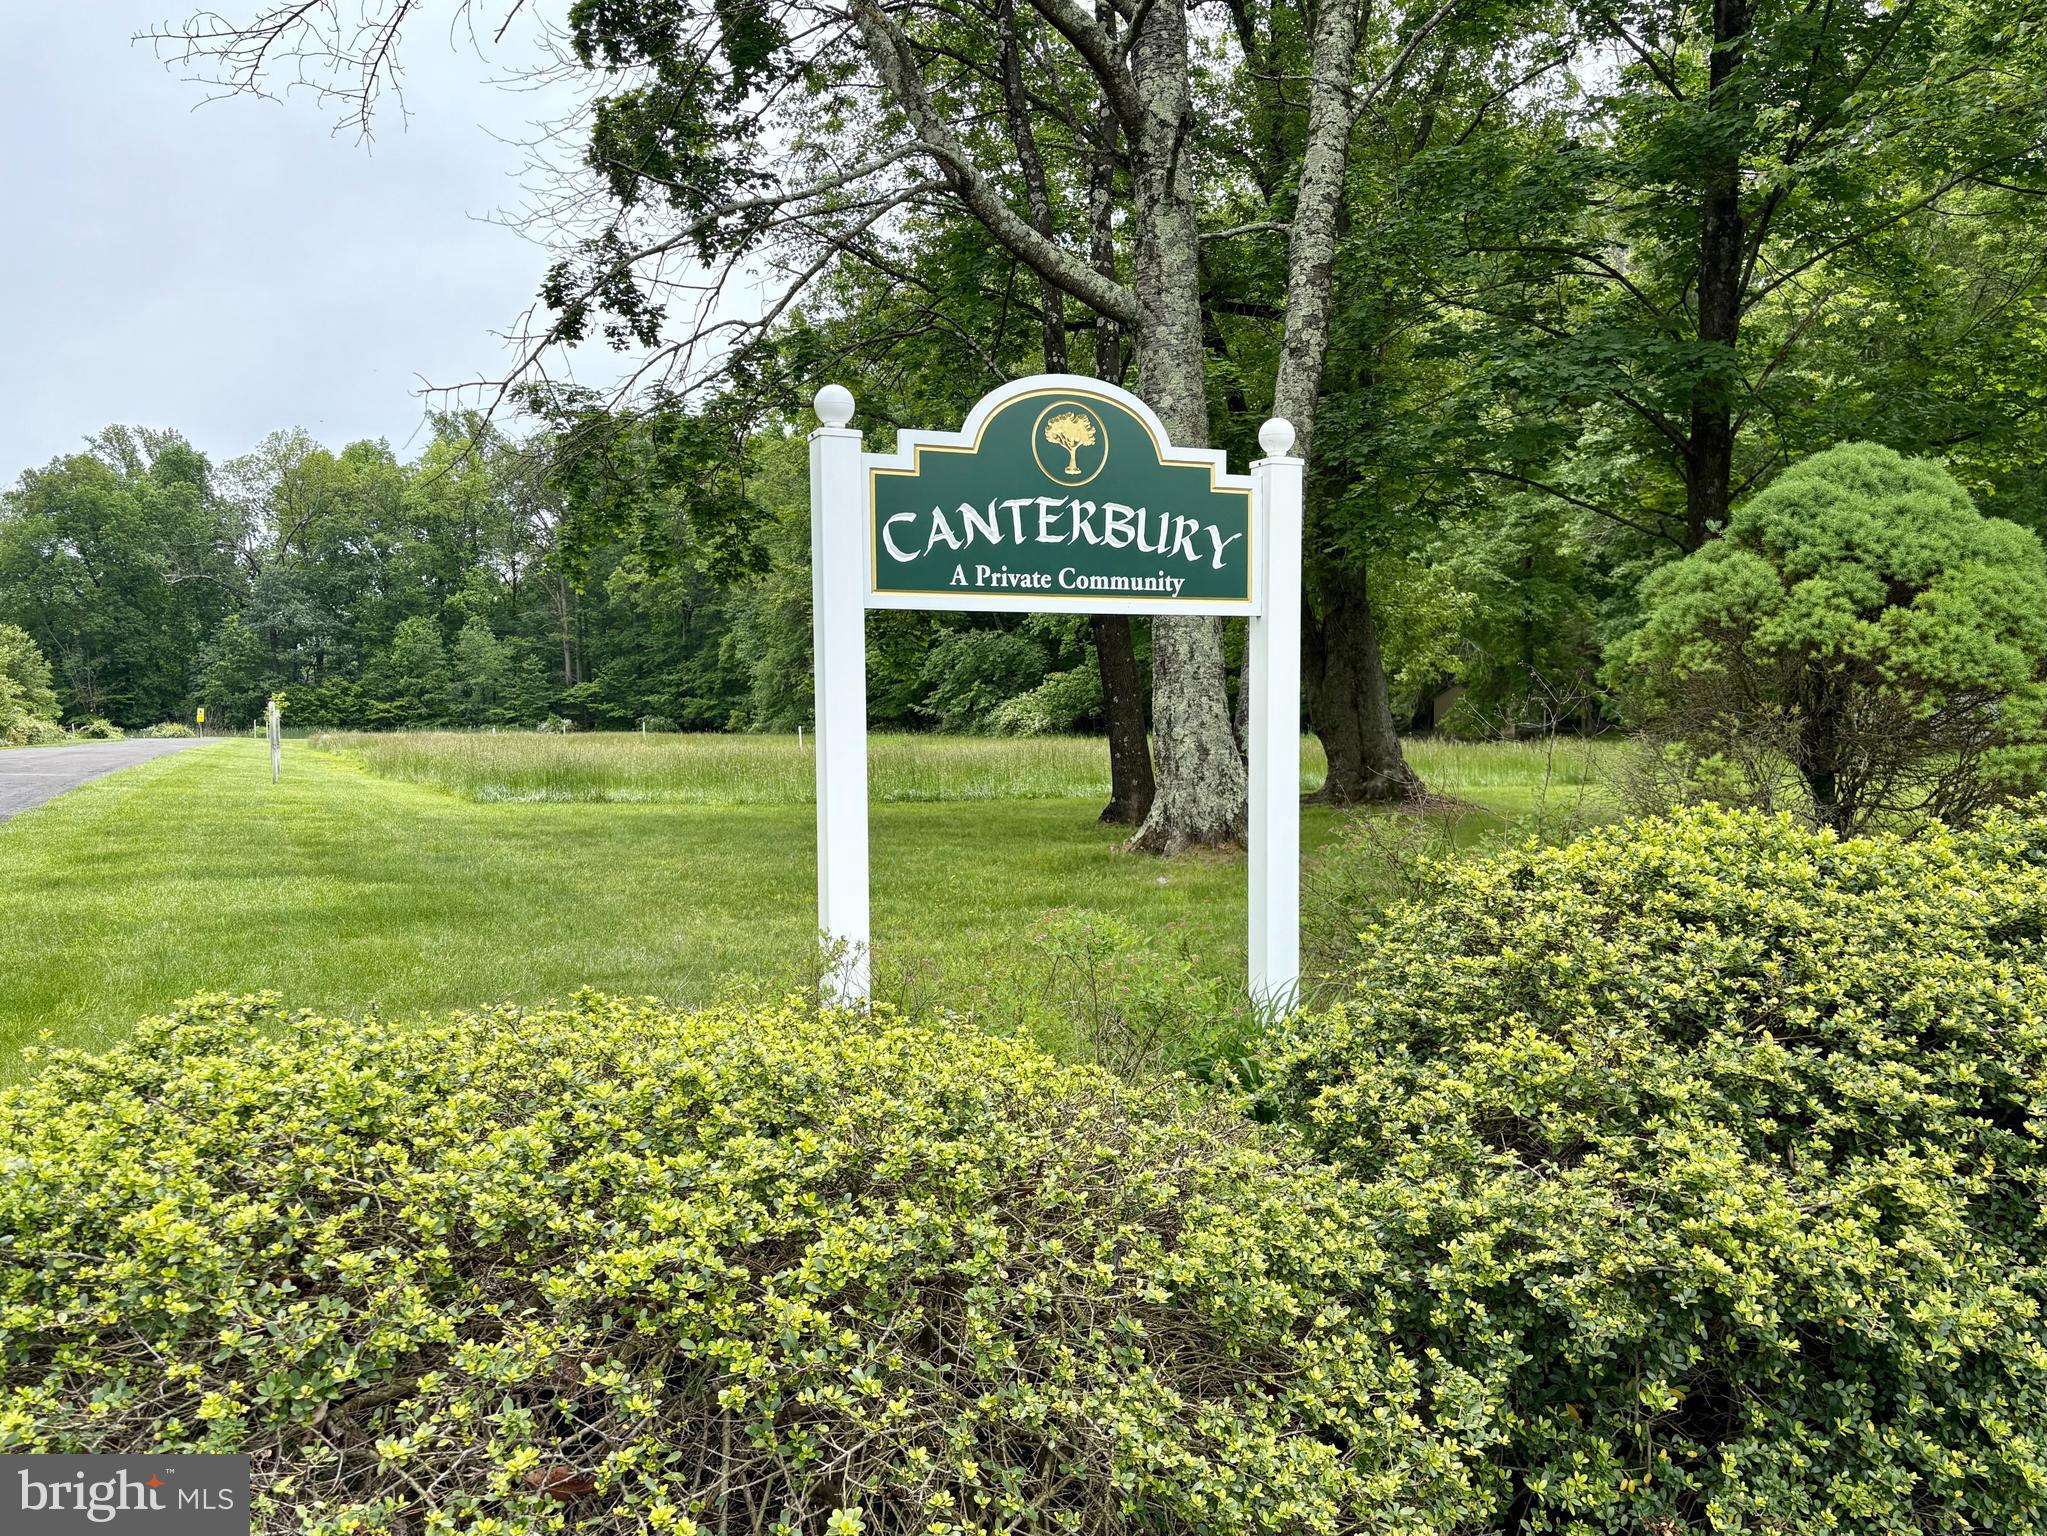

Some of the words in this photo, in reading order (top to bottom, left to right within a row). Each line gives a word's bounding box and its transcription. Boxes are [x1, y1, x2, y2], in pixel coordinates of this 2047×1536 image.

[882, 495, 1242, 569] CANTERBURY
[949, 565, 969, 586] A
[976, 566, 1052, 589] Private
[1058, 567, 1185, 598] Community
